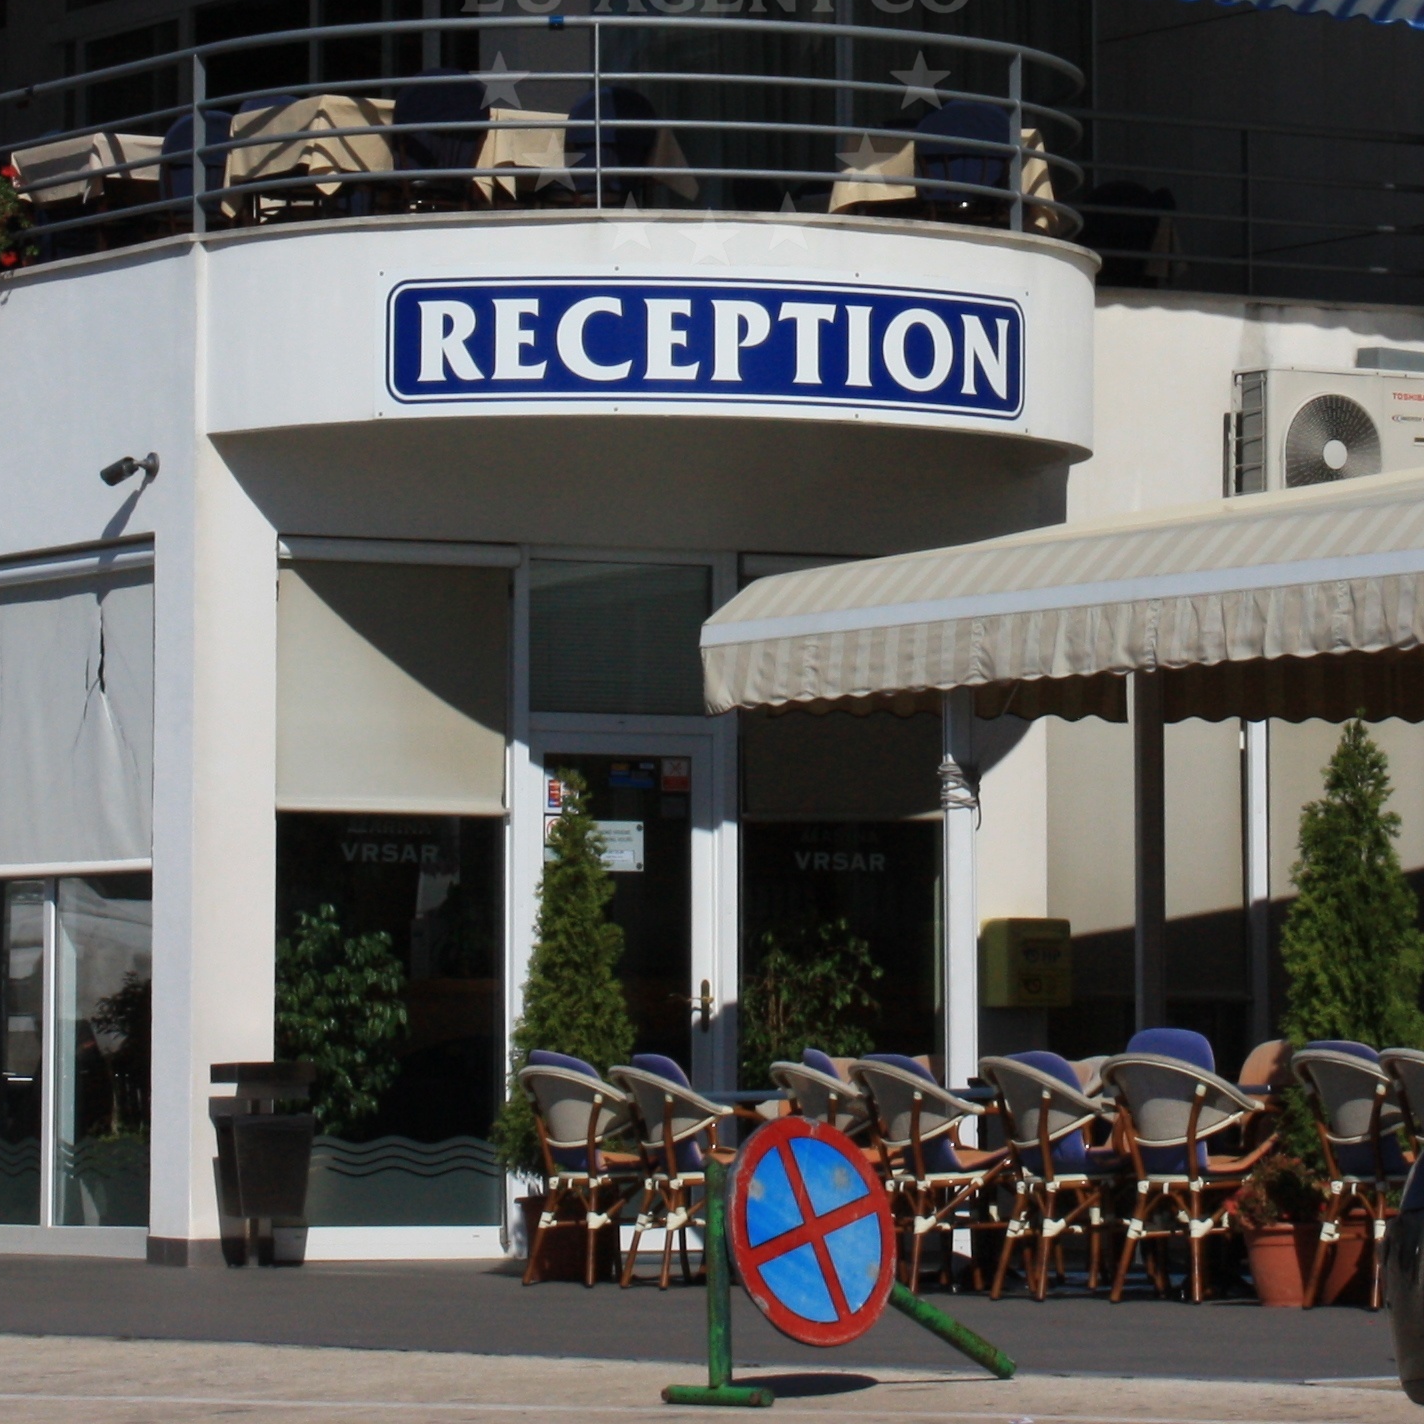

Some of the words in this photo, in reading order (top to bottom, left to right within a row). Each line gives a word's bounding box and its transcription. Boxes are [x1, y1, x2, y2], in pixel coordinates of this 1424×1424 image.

[417, 296, 1009, 400] RECEPTION
[341, 842, 439, 863] VRSAR
[794, 851, 886, 871] VRSAR
